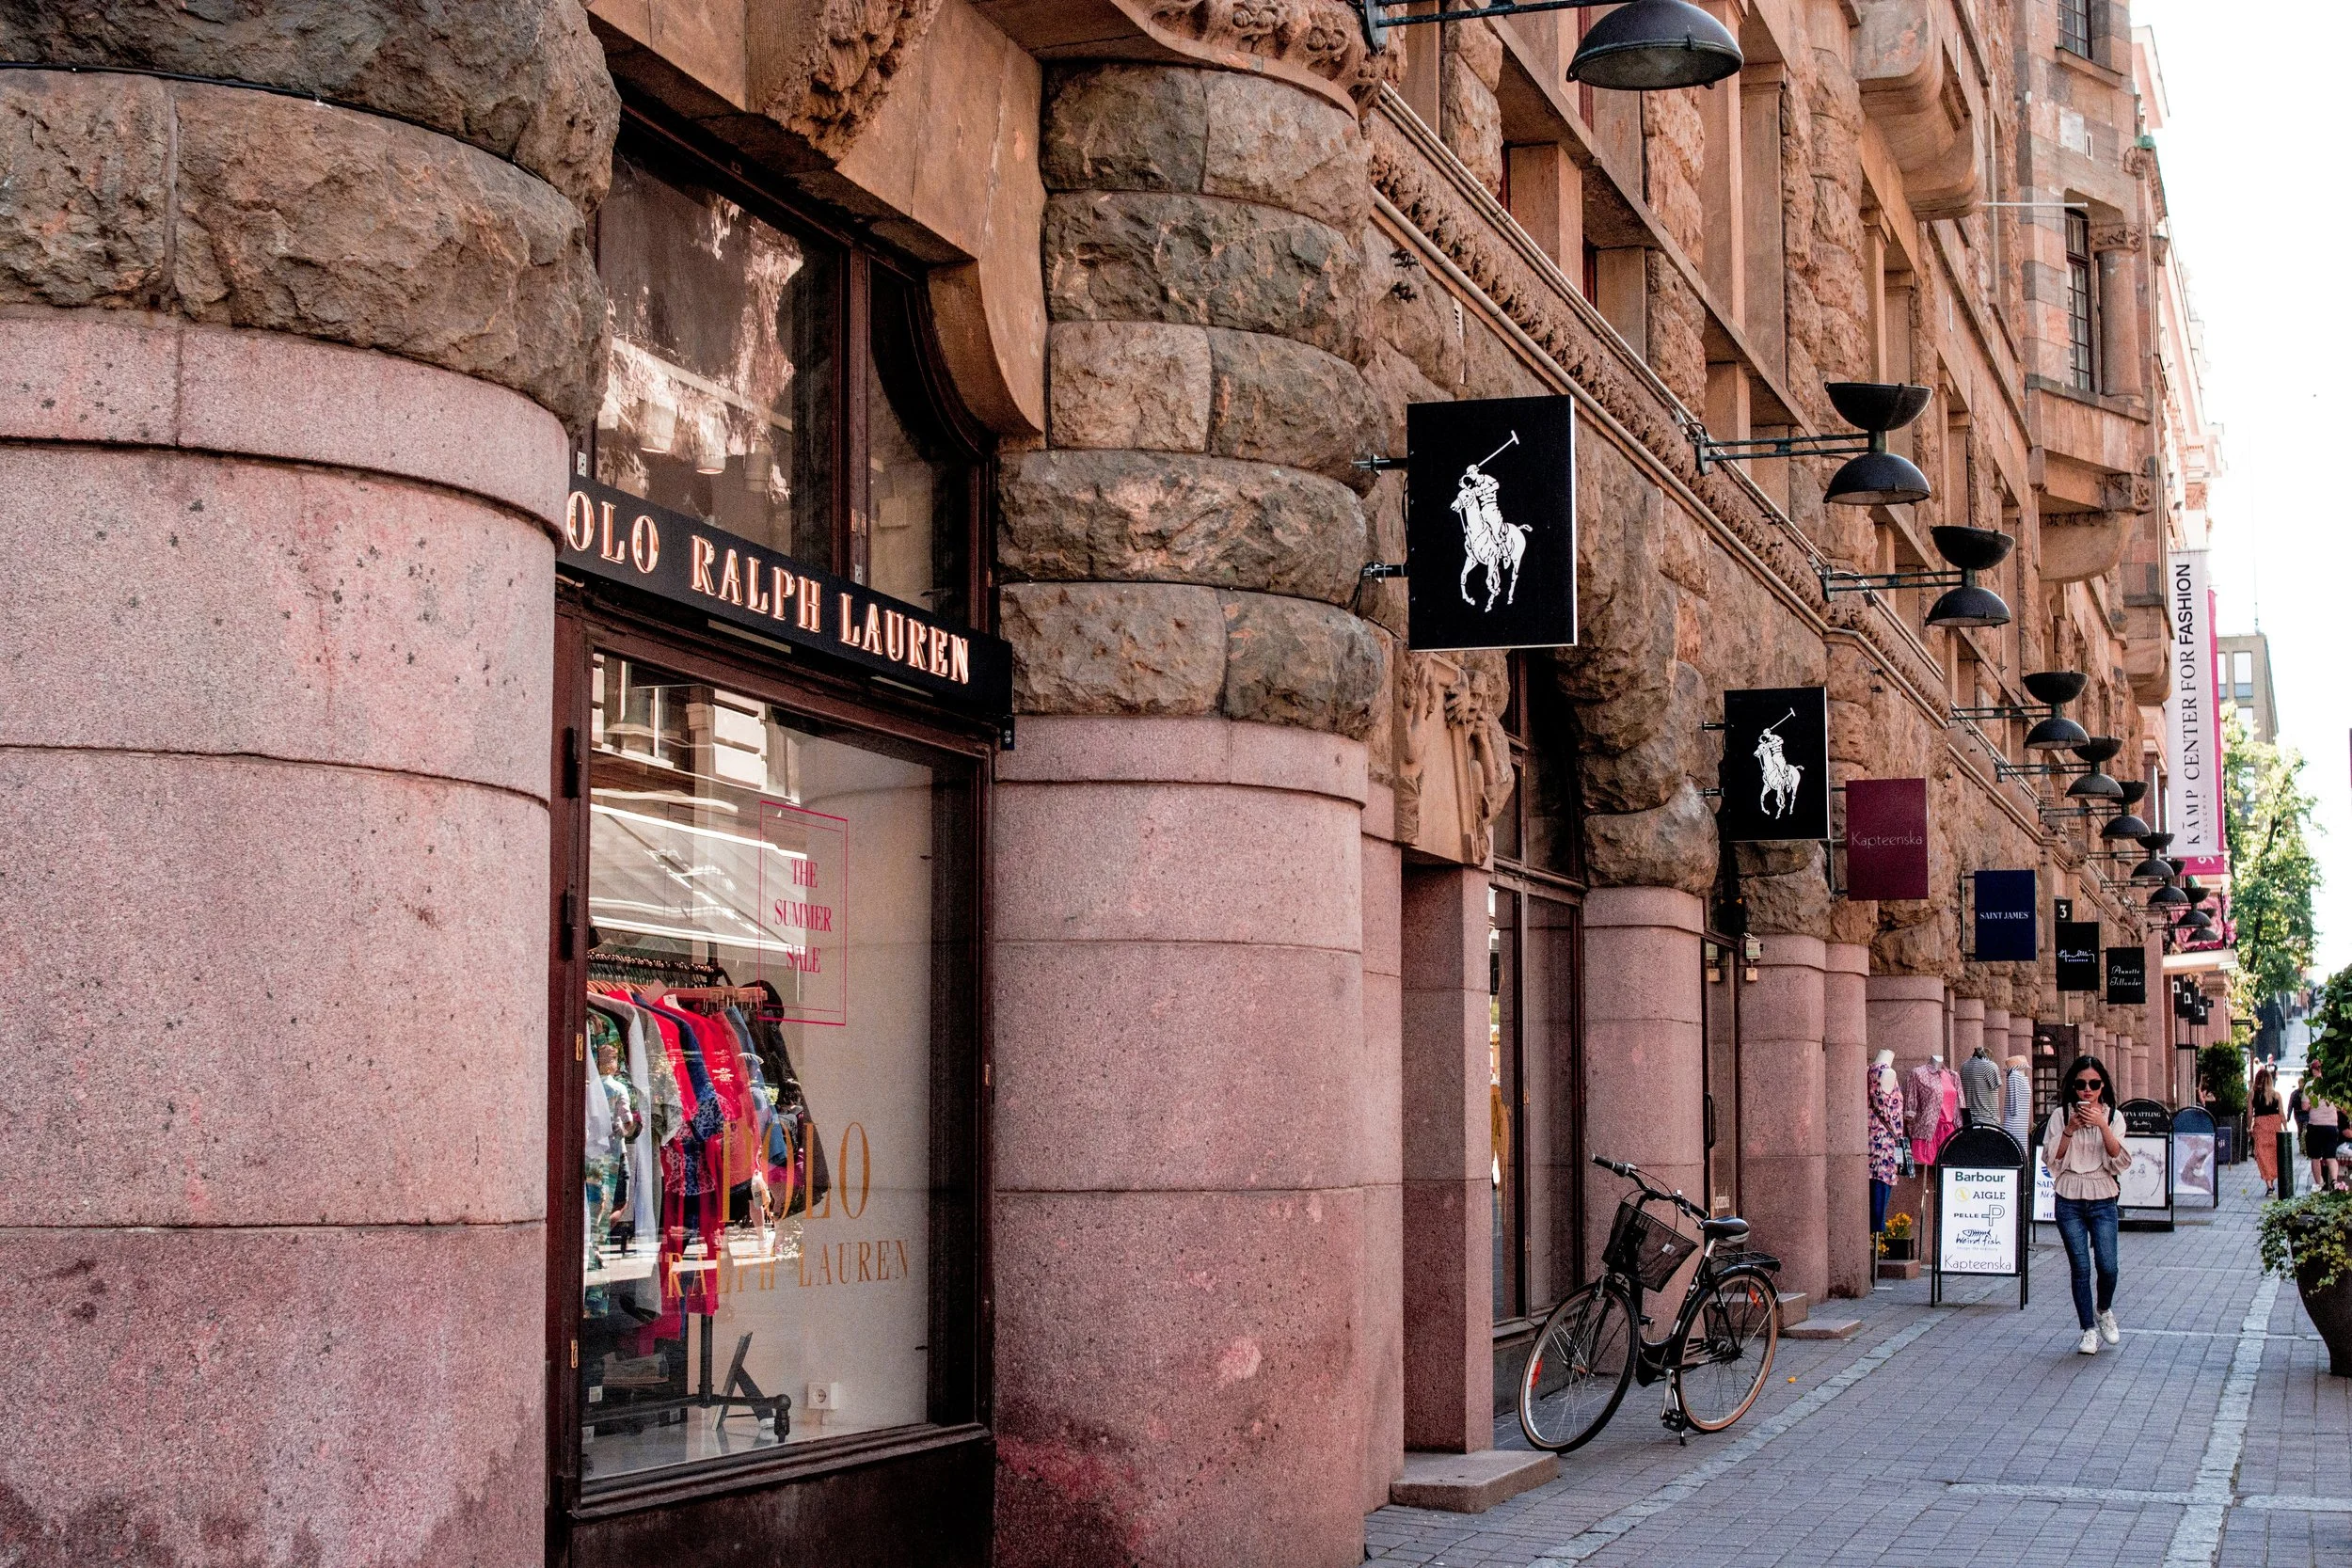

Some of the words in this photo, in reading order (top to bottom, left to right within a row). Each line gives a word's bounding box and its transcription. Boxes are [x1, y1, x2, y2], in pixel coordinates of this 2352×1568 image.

[565, 490, 660, 575] OLO
[691, 534, 822, 634] RALPH
[838, 592, 970, 685] LAUREN
[2175, 563, 2195, 646] FASHION
[2179, 649, 2198, 692] FOR
[2181, 697, 2201, 782] CENTER
[1851, 829, 1923, 849] Kapteenska
[791, 858, 818, 889] THE
[774, 898, 832, 933] SUMMER
[1979, 911, 2003, 920] SAINT
[2003, 911, 2029, 920] JAMES
[2059, 904, 2068, 919] 3
[786, 943, 821, 974] SALE
[719, 1120, 871, 1224] POLO
[1955, 1171, 2006, 1182] Barbour
[1972, 1191, 2006, 1200] AIGLE
[1982, 1234, 2001, 1246] fish
[666, 1247, 776, 1299] RALPH
[799, 1239, 910, 1288] LAUREN
[1944, 1254, 2011, 1271] Kapteenska
